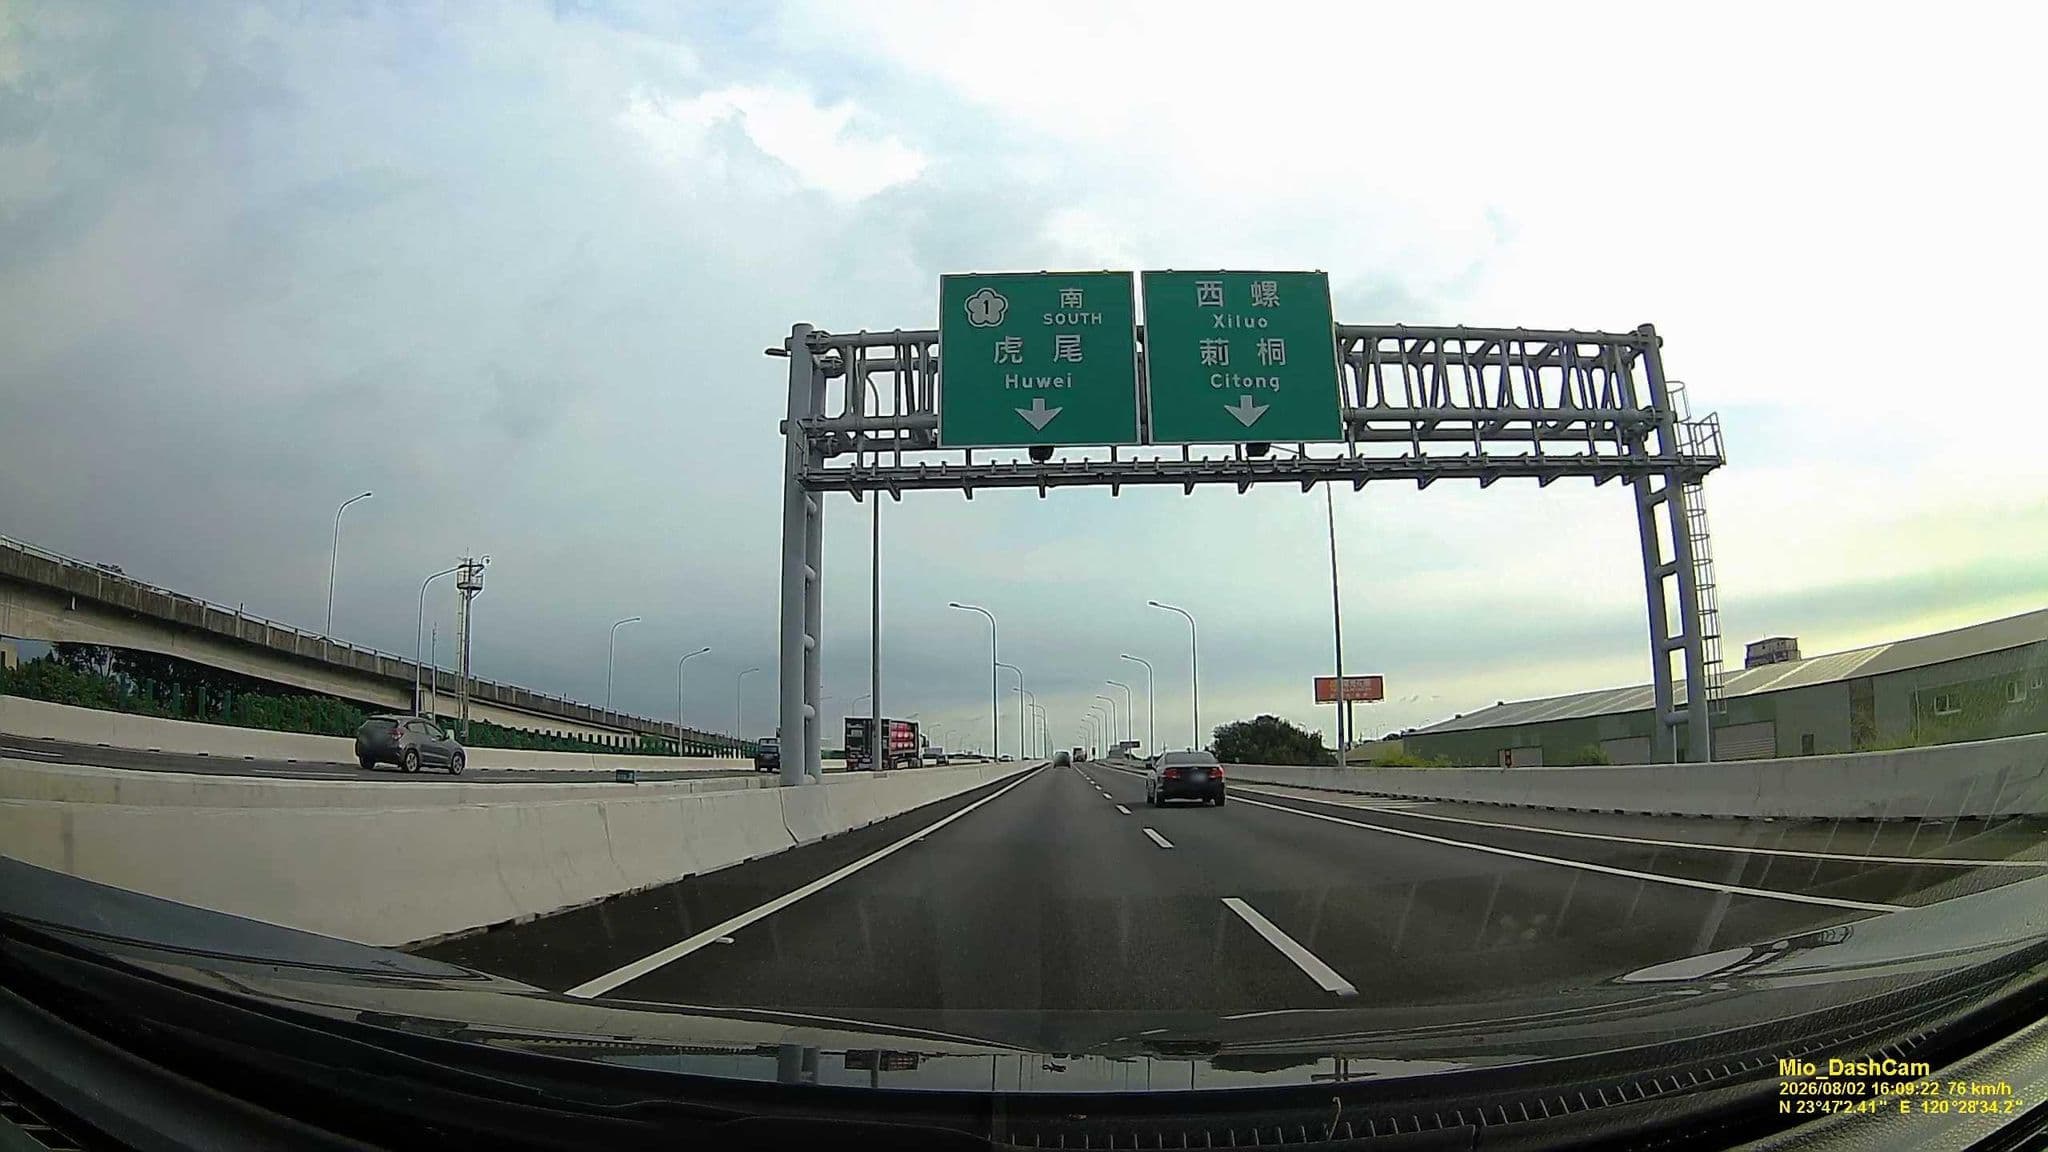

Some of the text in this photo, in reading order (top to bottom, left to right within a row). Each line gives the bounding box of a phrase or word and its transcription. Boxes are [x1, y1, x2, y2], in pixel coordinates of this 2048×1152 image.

[1059, 287, 1084, 309] 南
[1195, 280, 1281, 308] 西螺
[1043, 312, 1102, 325] SOUTH
[1213, 314, 1268, 328] Xiluo
[993, 334, 1083, 364] 虎尾
[1005, 372, 1071, 389] Huwei
[1210, 373, 1280, 392] Citong
